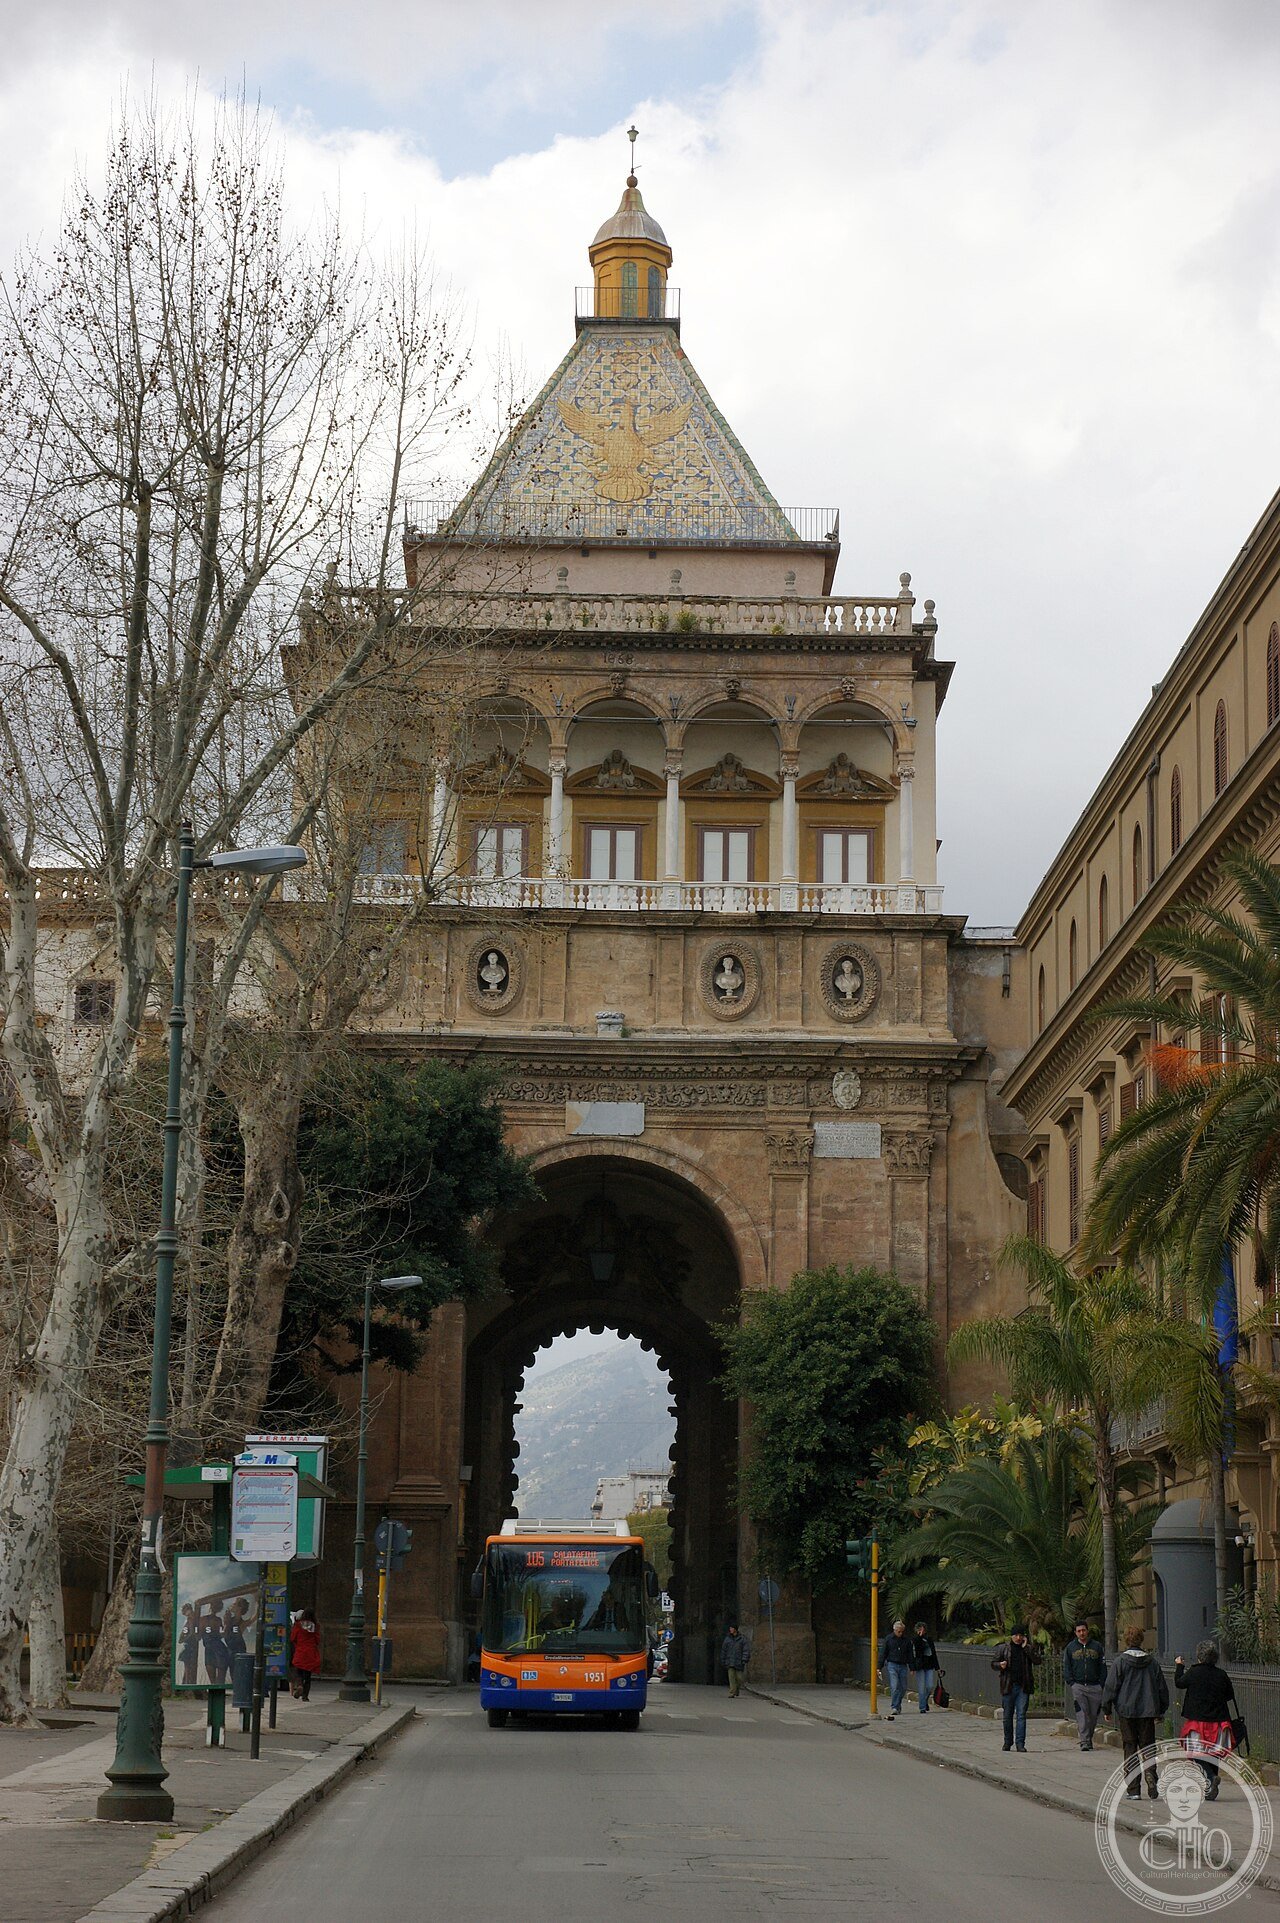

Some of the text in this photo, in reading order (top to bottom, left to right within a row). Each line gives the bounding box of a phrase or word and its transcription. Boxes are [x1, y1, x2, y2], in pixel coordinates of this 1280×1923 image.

[526, 1551, 545, 1567] 105
[553, 1550, 598, 1559] CALATAFIMI
[182, 1626, 253, 1634] SISLEY
[584, 1672, 605, 1683] 1951
